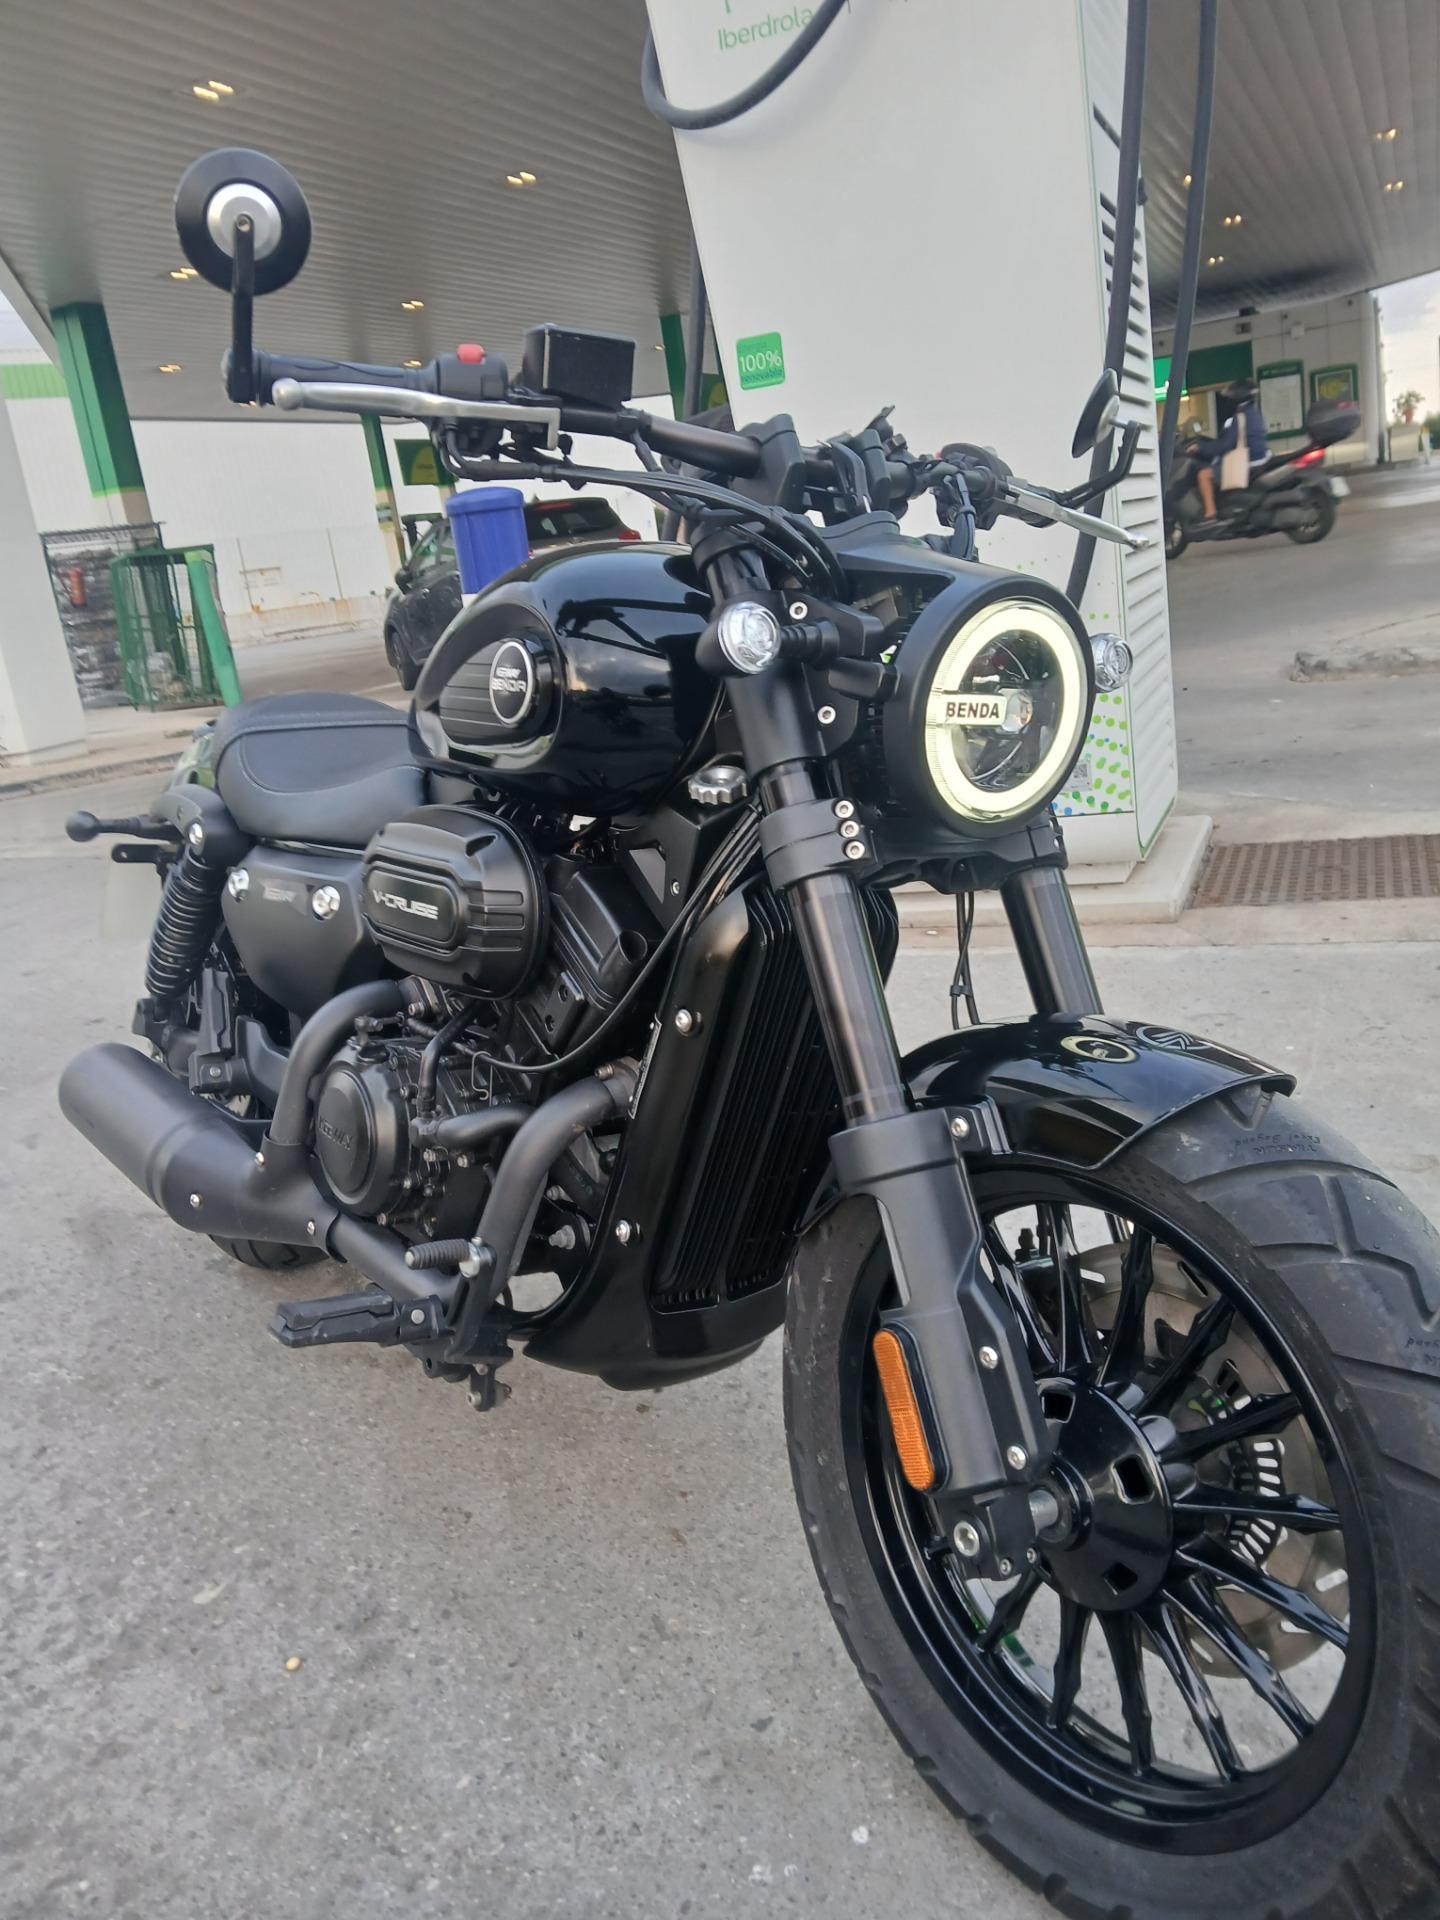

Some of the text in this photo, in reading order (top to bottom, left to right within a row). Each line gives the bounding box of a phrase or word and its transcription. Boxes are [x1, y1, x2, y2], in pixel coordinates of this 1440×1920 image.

[718, 7, 814, 50] Iberdrola
[739, 350, 782, 372] 100%
[945, 702, 1000, 719] BENDA
[372, 889, 439, 920] V-CRUISE
